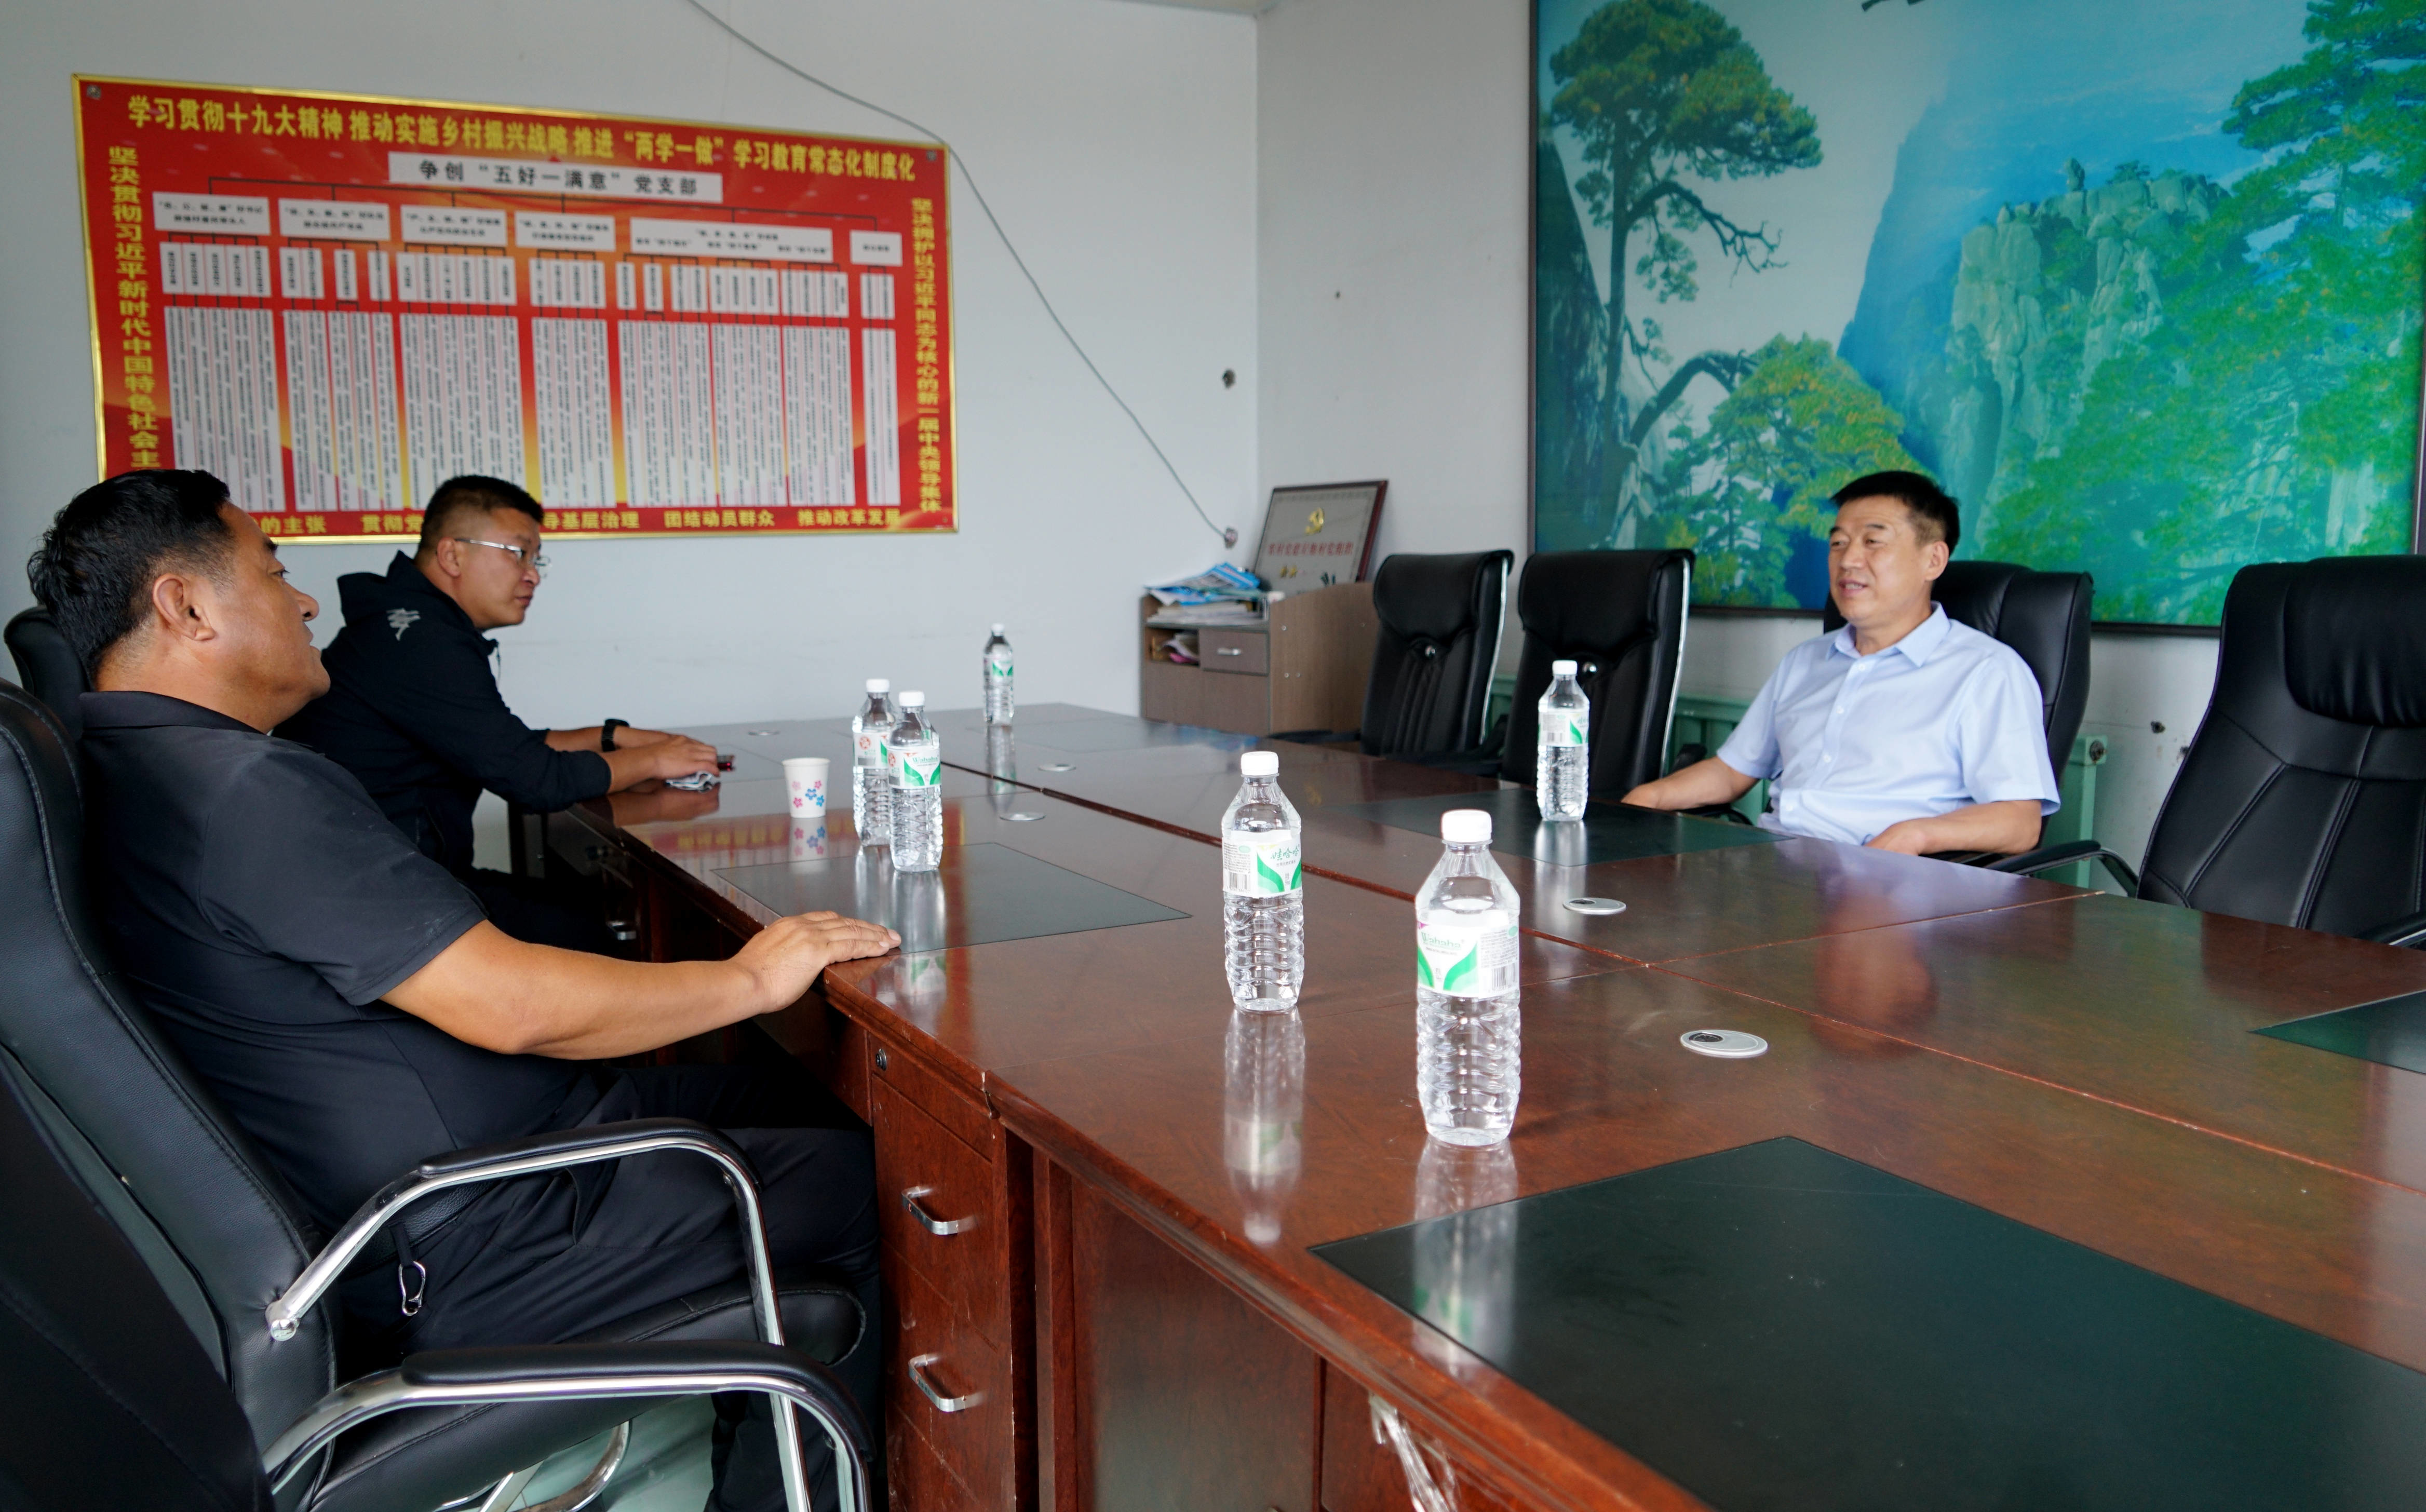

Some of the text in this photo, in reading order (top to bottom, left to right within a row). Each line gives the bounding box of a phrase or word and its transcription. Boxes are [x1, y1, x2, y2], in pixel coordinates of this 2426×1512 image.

[128, 95, 343, 140] 学习贯彻十九大精神
[349, 109, 568, 154] 推动实施乡村振兴战略
[664, 509, 775, 528] 团结动员群众
[797, 508, 900, 526] 推动改革发展
[1270, 845, 1299, 861] 娃哈哈
[1421, 932, 1461, 948] Wahaha
